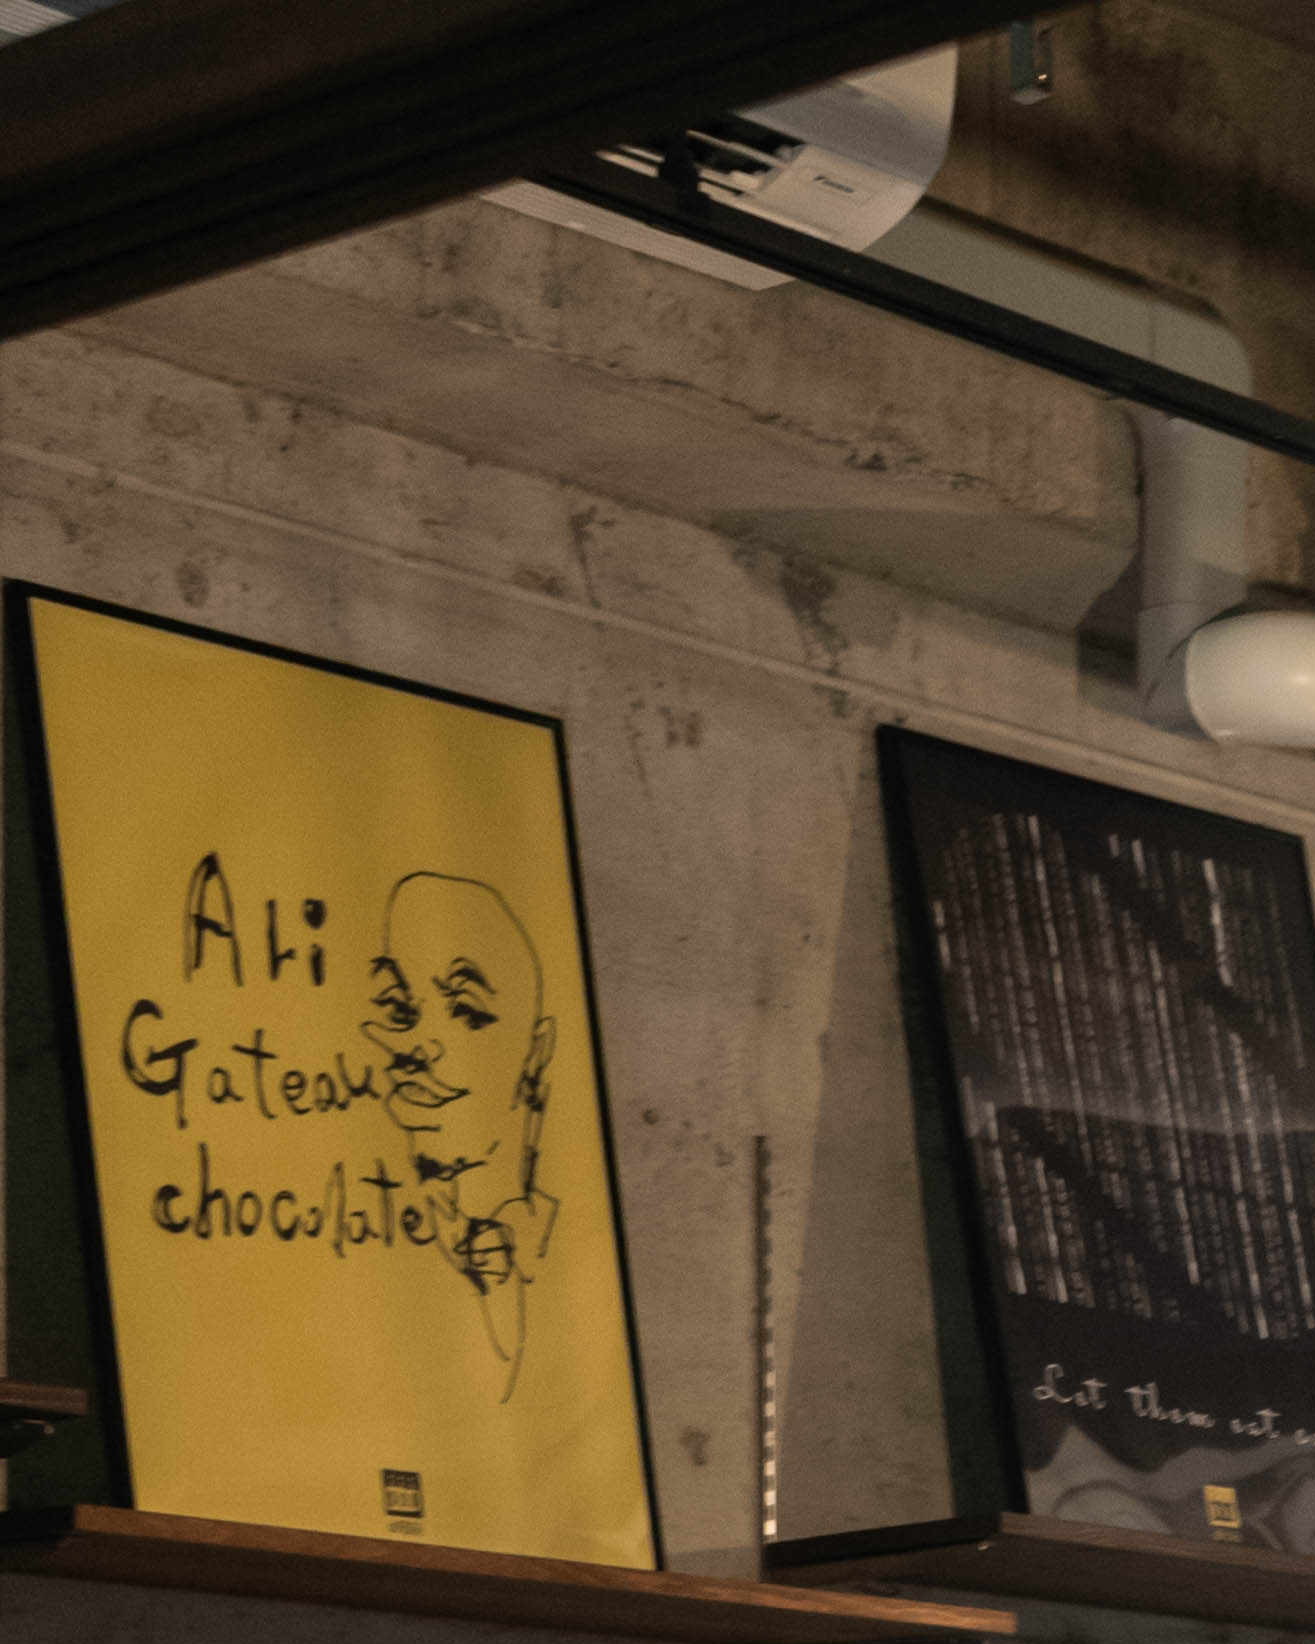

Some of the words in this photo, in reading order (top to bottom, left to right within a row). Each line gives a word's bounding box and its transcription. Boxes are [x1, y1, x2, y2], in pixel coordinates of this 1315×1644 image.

[121, 998, 381, 1130] Gateau
[152, 1141, 436, 1258] chocolate
[1032, 1363, 1108, 1410] Let
[1125, 1382, 1215, 1428] them
